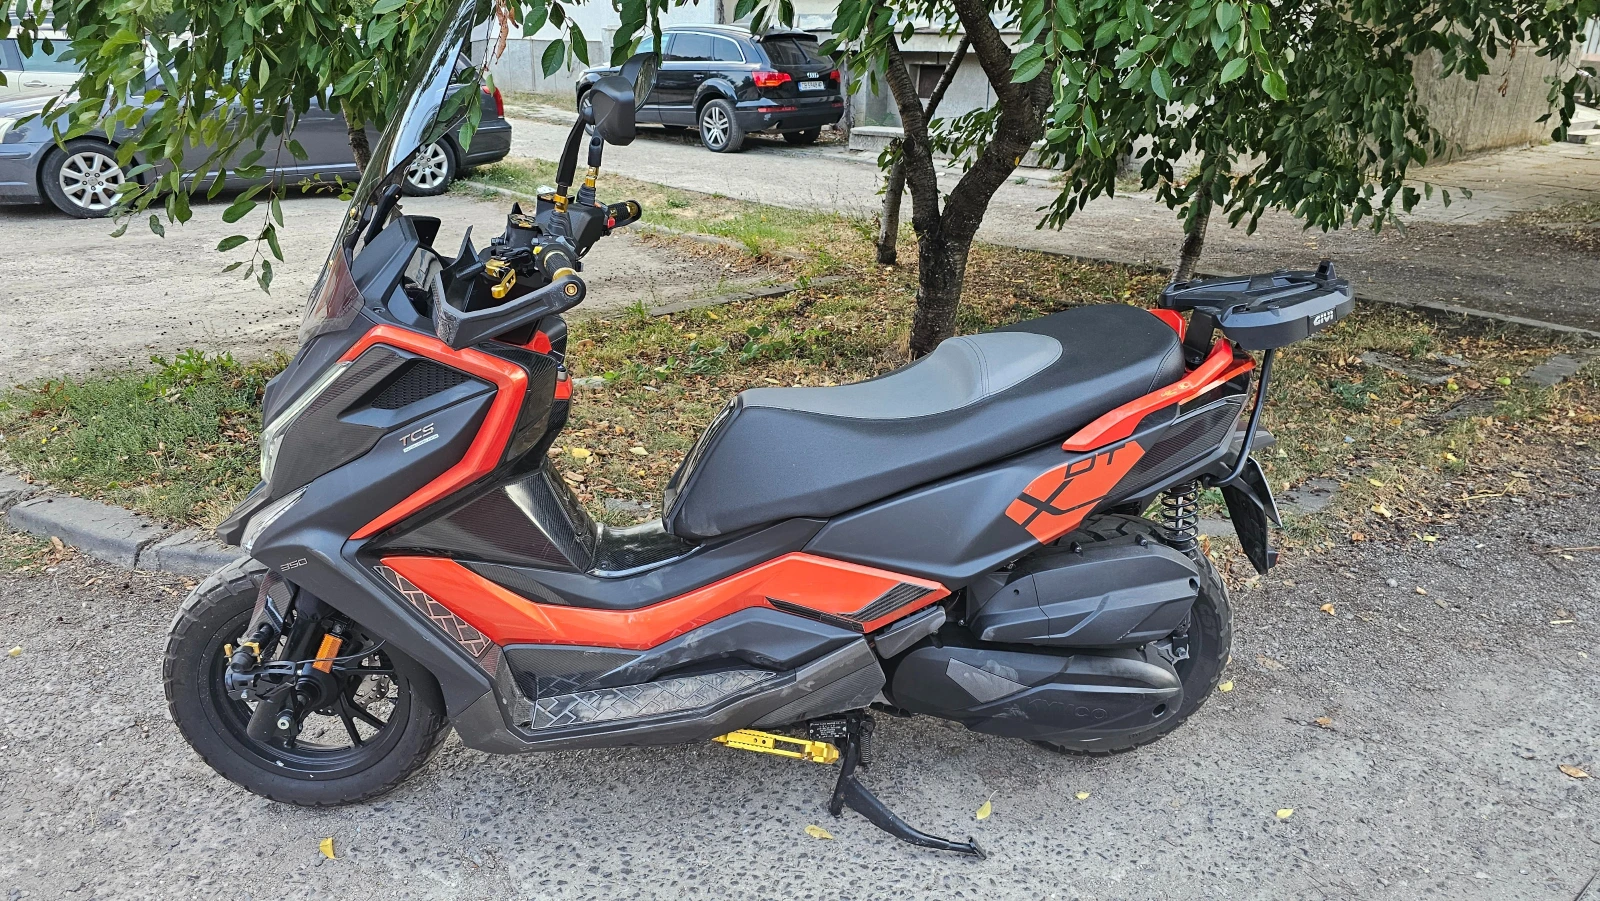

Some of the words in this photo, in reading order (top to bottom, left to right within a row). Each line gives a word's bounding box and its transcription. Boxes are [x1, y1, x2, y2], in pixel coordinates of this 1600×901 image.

[1312, 310, 1334, 326] GIVI
[398, 422, 434, 447] TCS
[280, 557, 308, 572] 350
